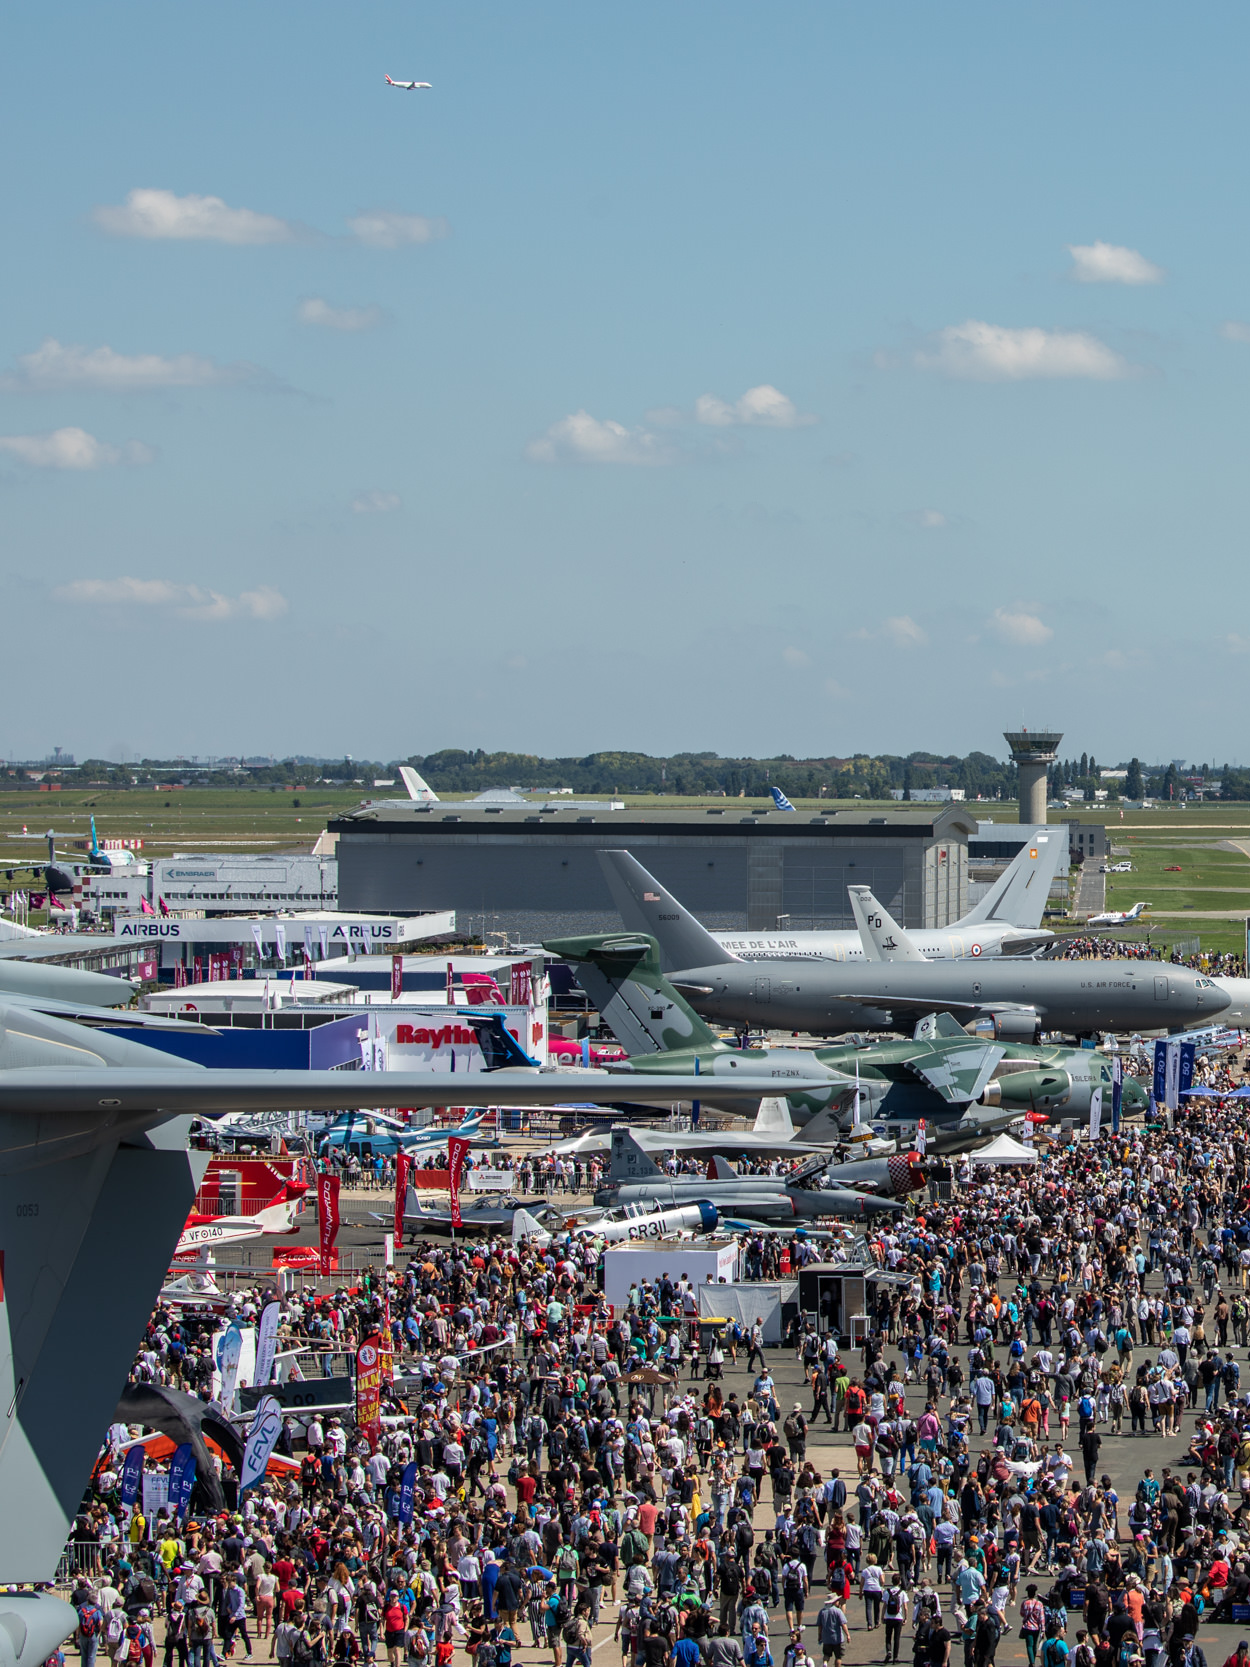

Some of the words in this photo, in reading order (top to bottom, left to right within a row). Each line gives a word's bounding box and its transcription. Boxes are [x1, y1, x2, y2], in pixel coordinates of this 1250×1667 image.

[120, 924, 180, 936] AIRBUS
[332, 925, 392, 938] ARUS
[720, 941, 747, 949] MEE
[750, 941, 765, 949] DE
[768, 940, 798, 949] L'AIR
[1157, 1061, 1165, 1074] 50
[1183, 1062, 1190, 1076] 50
[189, 1232, 200, 1241] VF
[209, 1227, 223, 1237] 140
